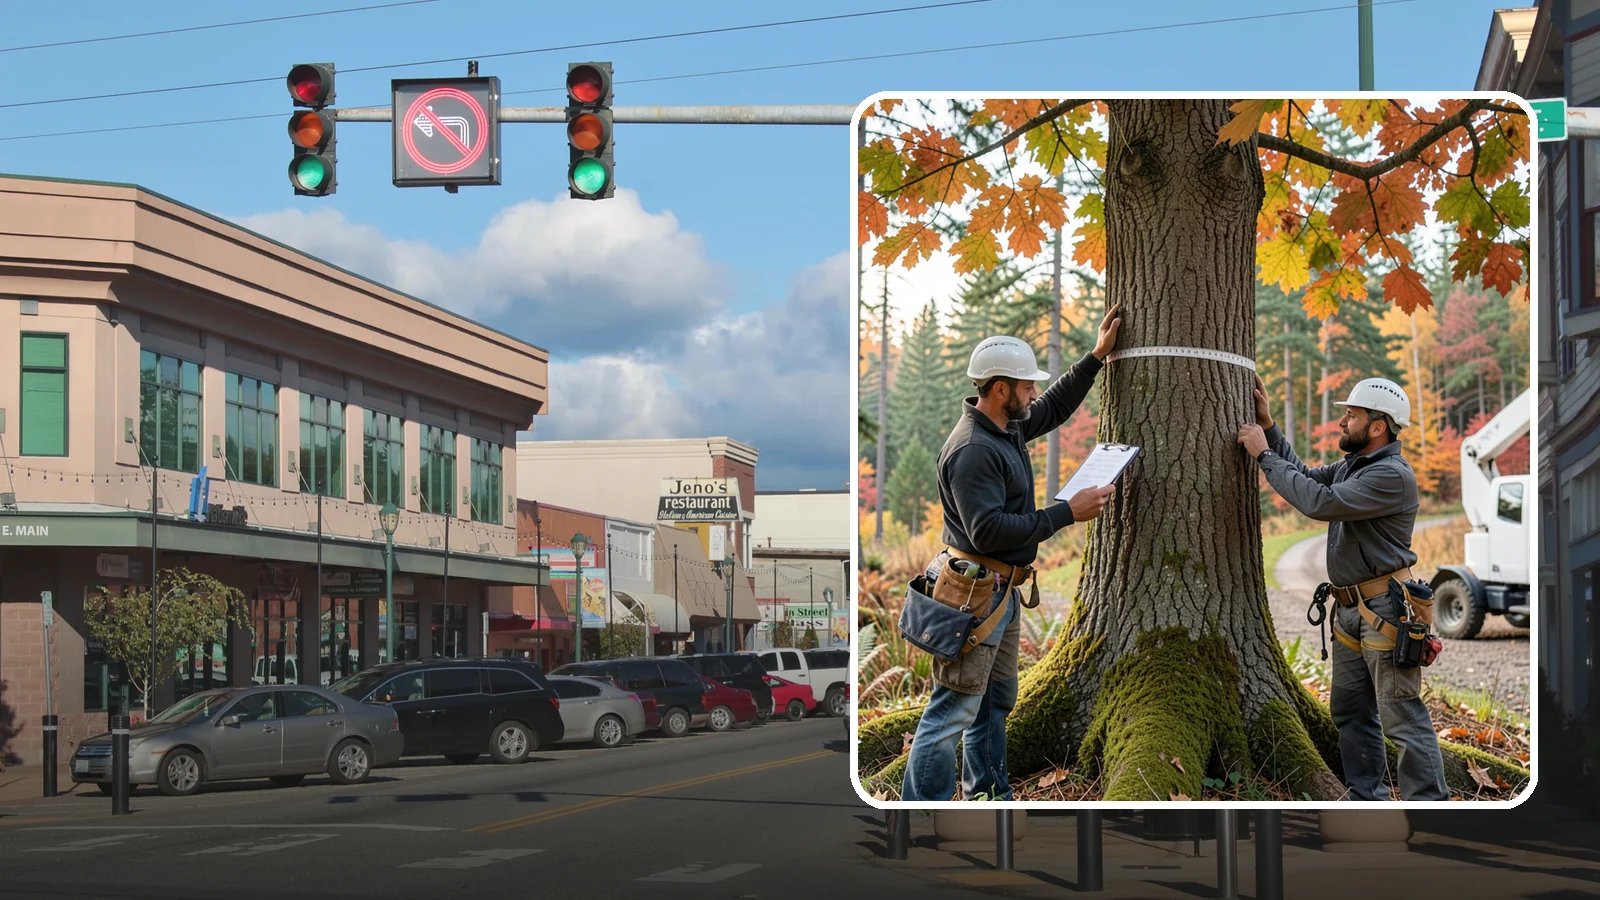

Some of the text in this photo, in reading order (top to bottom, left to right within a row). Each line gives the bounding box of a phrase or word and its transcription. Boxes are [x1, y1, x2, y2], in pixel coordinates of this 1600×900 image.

[670, 480, 727, 494] Jeno's
[665, 496, 731, 509] restaurant
[658, 509, 682, 519] Italian
[686, 509, 715, 519] American
[715, 509, 737, 519] Cuisine
[2, 525, 49, 536] E. MAIN
[785, 607, 795, 616] in
[797, 607, 829, 617] Street
[790, 619, 824, 627] lass
